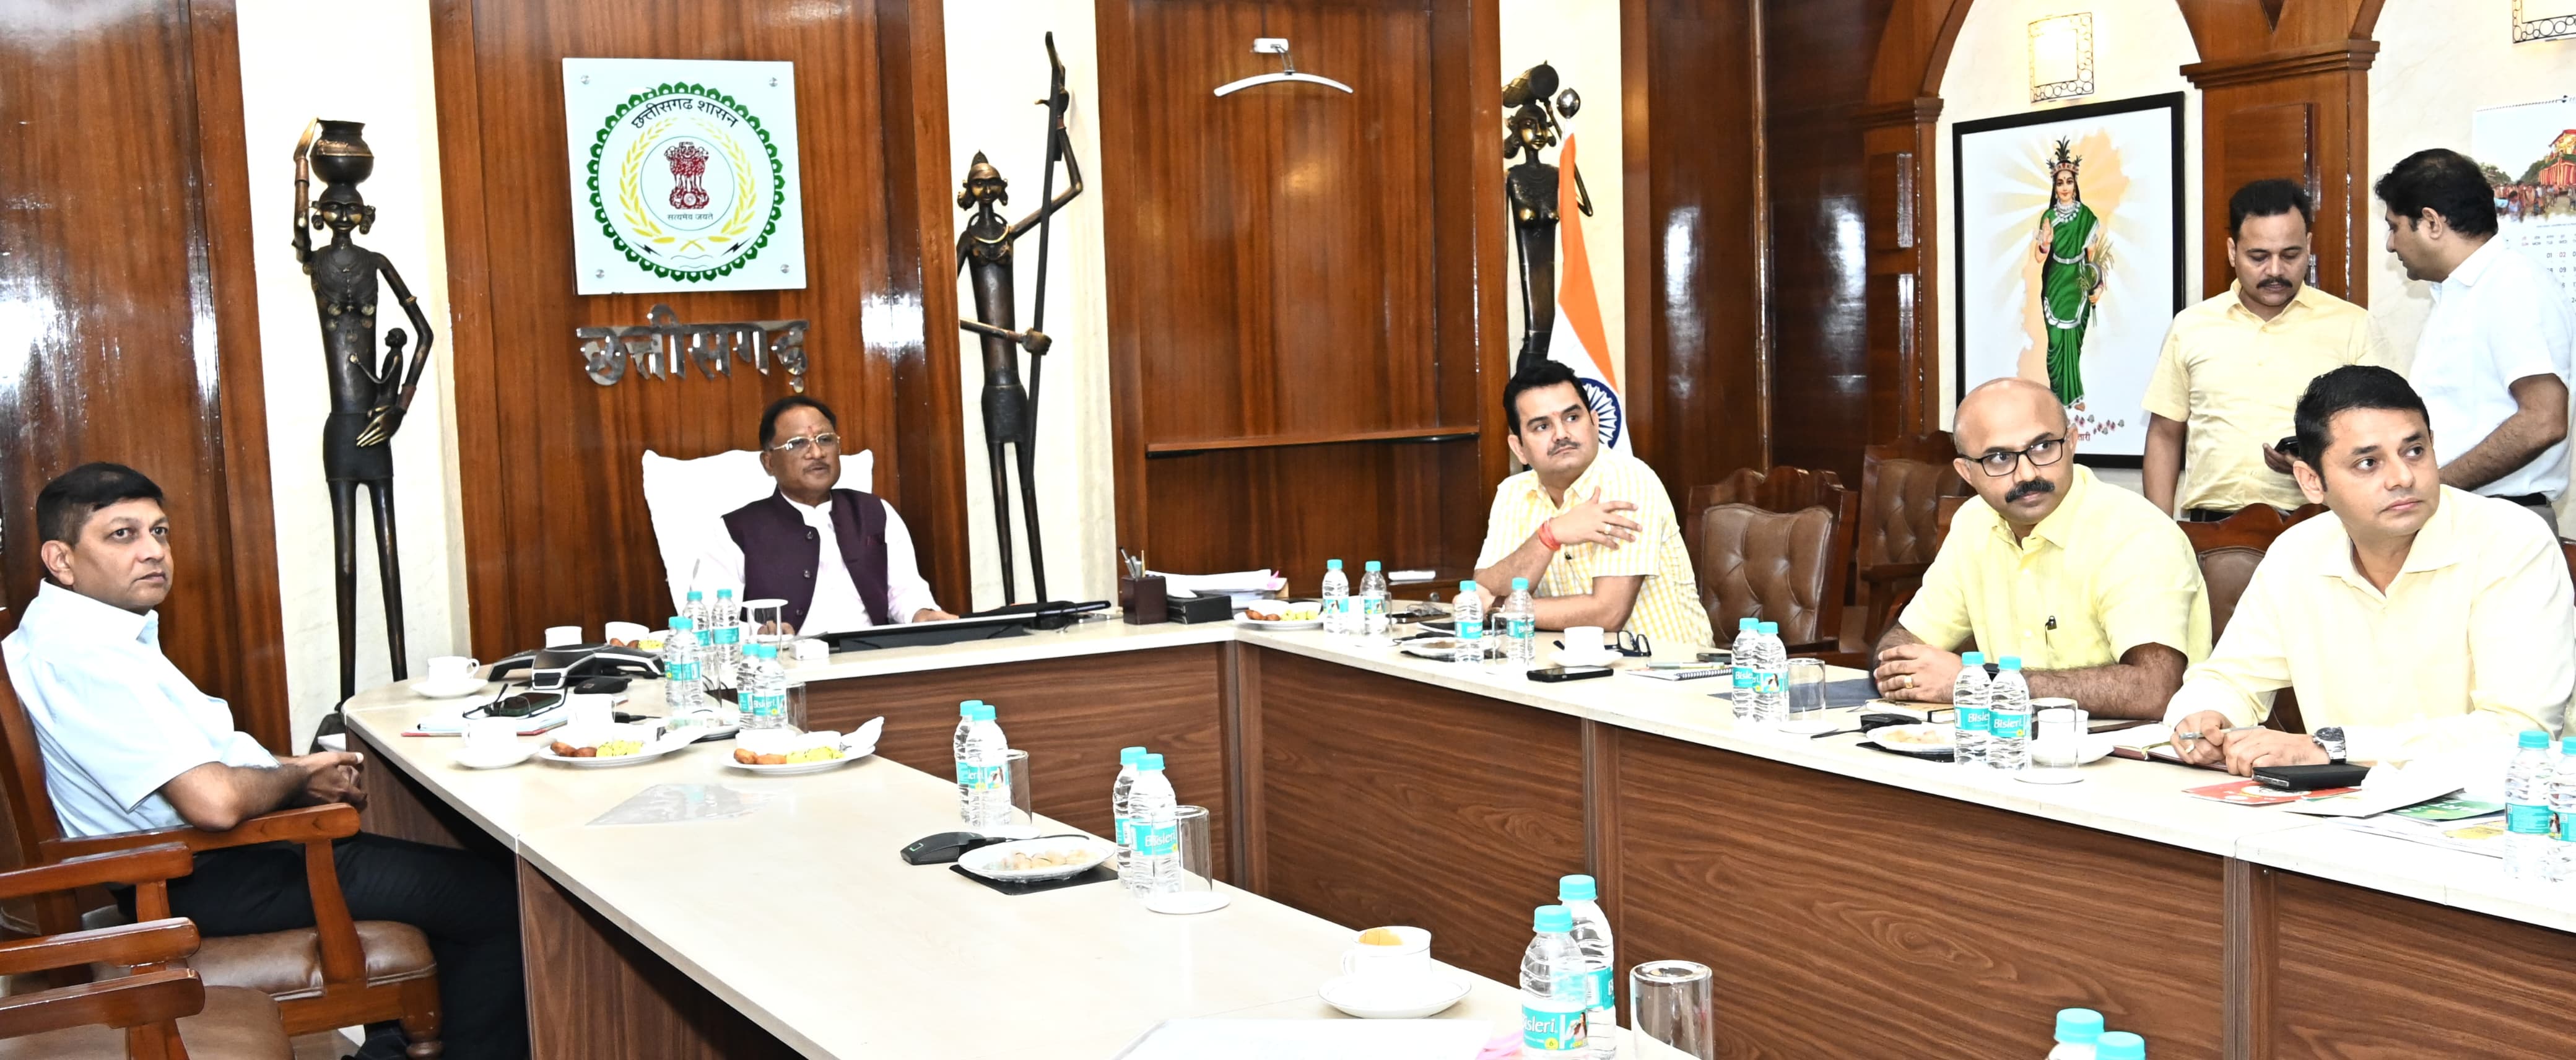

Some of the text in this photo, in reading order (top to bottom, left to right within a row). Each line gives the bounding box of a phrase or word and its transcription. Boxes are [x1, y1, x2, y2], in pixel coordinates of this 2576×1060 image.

[698, 100, 738, 128] शासन
[576, 303, 809, 393] छत्तीसगढ़
[1968, 711, 1990, 723] Bisle
[1995, 717, 2022, 728] Bisleri
[1523, 1014, 1556, 1033] isleri
